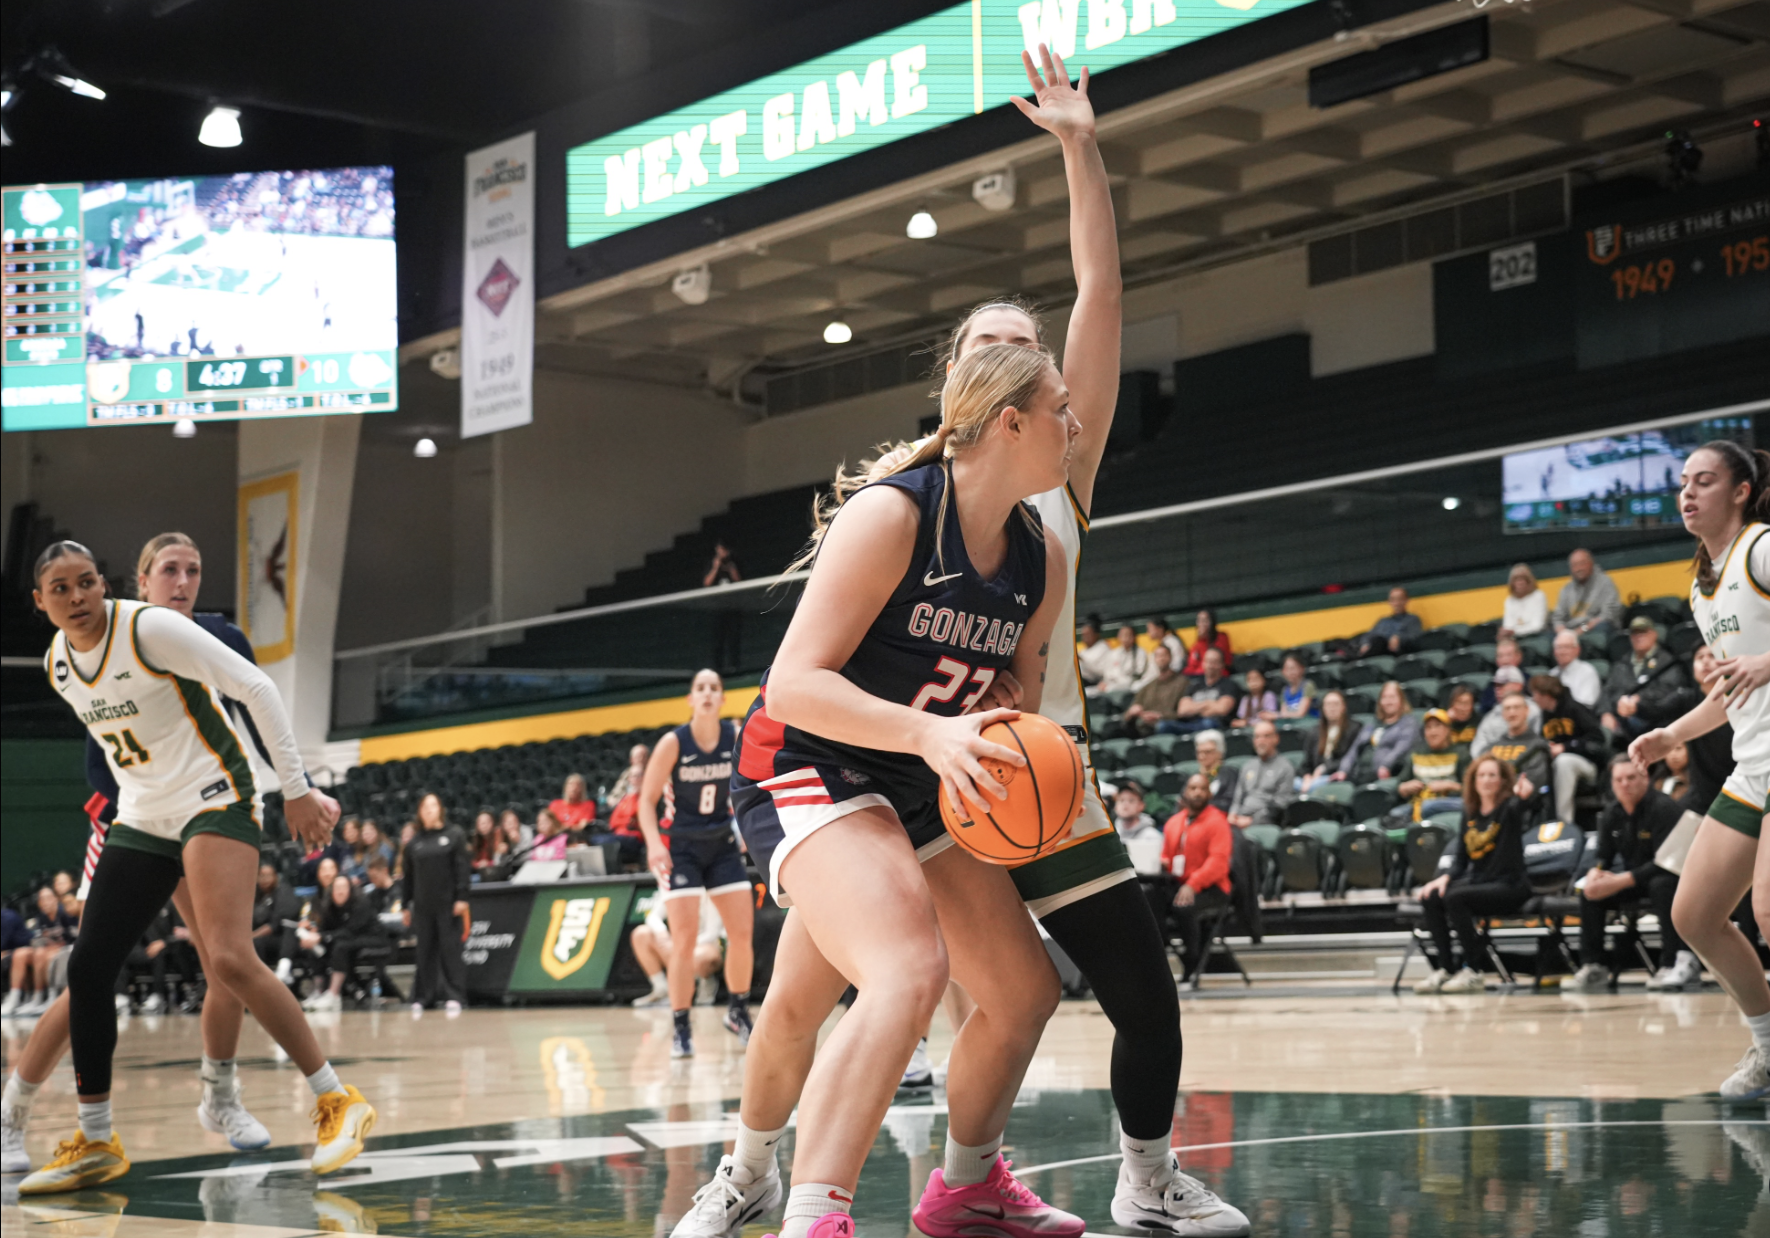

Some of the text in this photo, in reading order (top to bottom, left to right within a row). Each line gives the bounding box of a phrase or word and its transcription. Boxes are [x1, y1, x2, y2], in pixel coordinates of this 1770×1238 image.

[604, 44, 928, 217] NEXT GAME
[1624, 220, 1680, 249] THREE
[1683, 209, 1726, 236] TIME
[1492, 251, 1535, 284] 202
[1610, 236, 1770, 301] 1949 195
[155, 367, 174, 394] 8
[198, 360, 248, 388] 4:37
[311, 358, 340, 384] 10
[908, 602, 1025, 657] GONZAGA
[81, 699, 139, 725] RANCISCO
[90, 698, 107, 708] SAN
[100, 728, 151, 769] 21
[699, 783, 718, 816] 8
